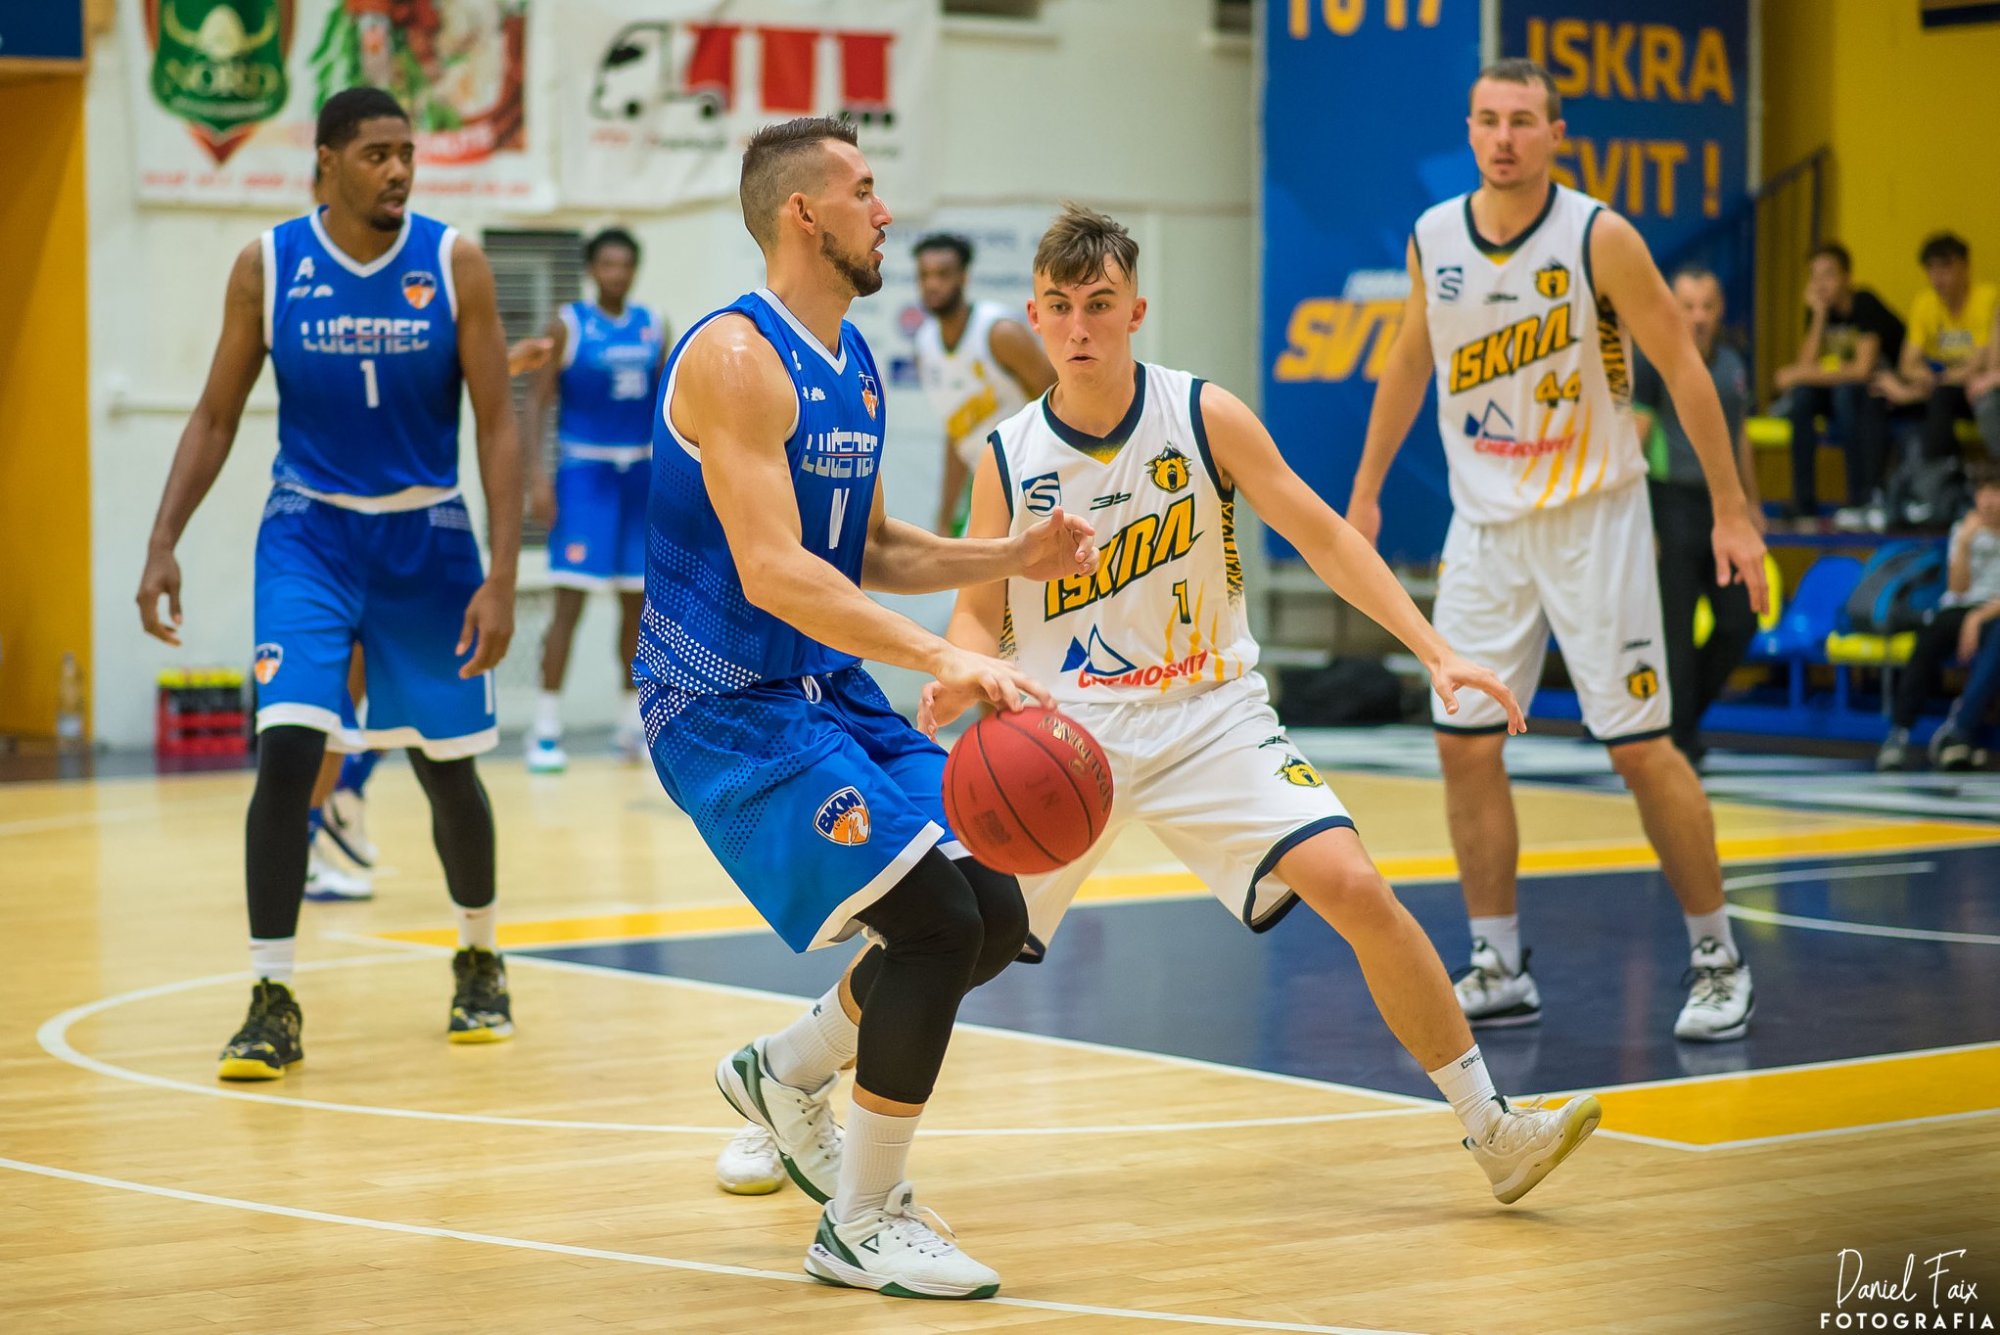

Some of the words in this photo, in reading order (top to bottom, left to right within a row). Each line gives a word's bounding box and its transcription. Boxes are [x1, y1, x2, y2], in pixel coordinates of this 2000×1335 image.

[1528, 18, 1732, 103] ISKRA
[1449, 303, 1578, 396] ISKRA
[360, 360, 379, 408] 1
[1172, 579, 1191, 624] 1
[818, 792, 861, 834] BKM
